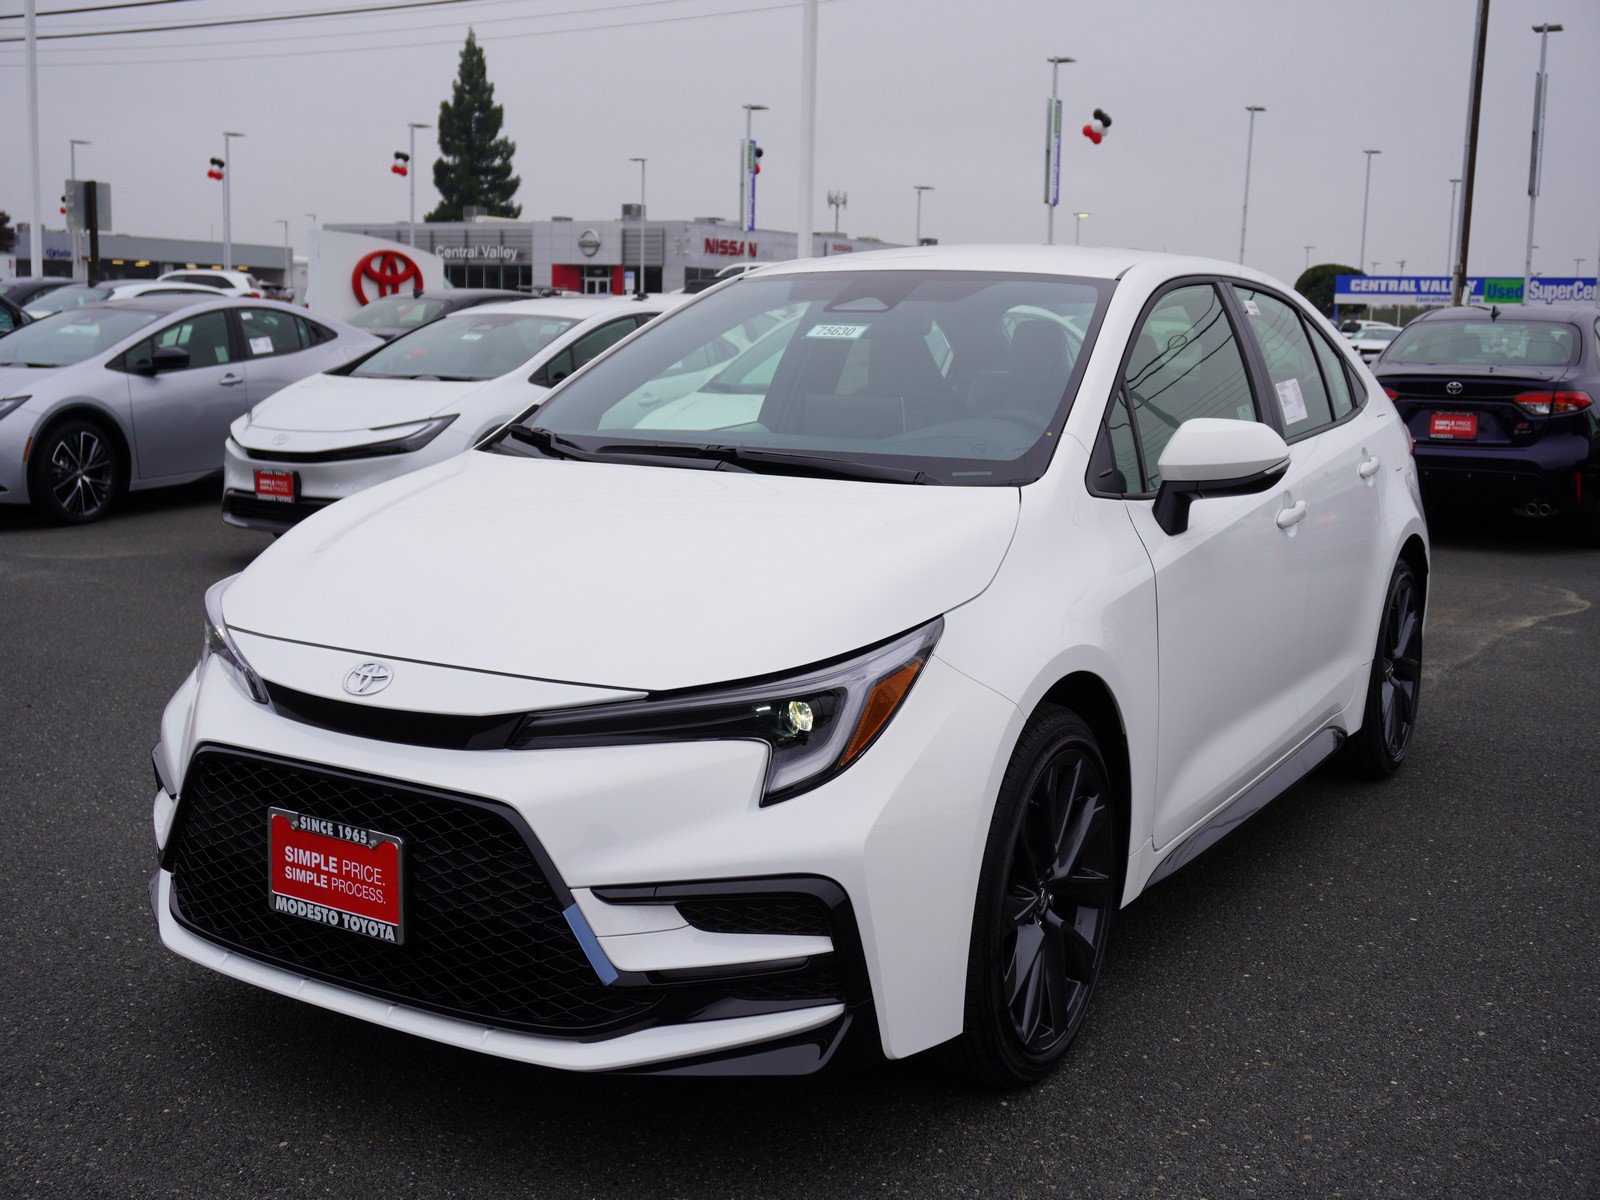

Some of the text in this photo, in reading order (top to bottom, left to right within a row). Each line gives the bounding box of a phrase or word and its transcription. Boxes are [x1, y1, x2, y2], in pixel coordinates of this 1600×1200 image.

[435, 244, 518, 262] Central Valley
[704, 237, 757, 258] NISSAN
[1350, 279, 1418, 293] CENTRAL
[1487, 283, 1524, 300] Used
[816, 326, 857, 336] 75630
[300, 816, 368, 844] SINCE 1965
[284, 845, 386, 887] SIMPLE PRICE.
[285, 866, 386, 904] SIMPLE PROCESS.
[275, 895, 396, 942] MODESTO TOYOTA
